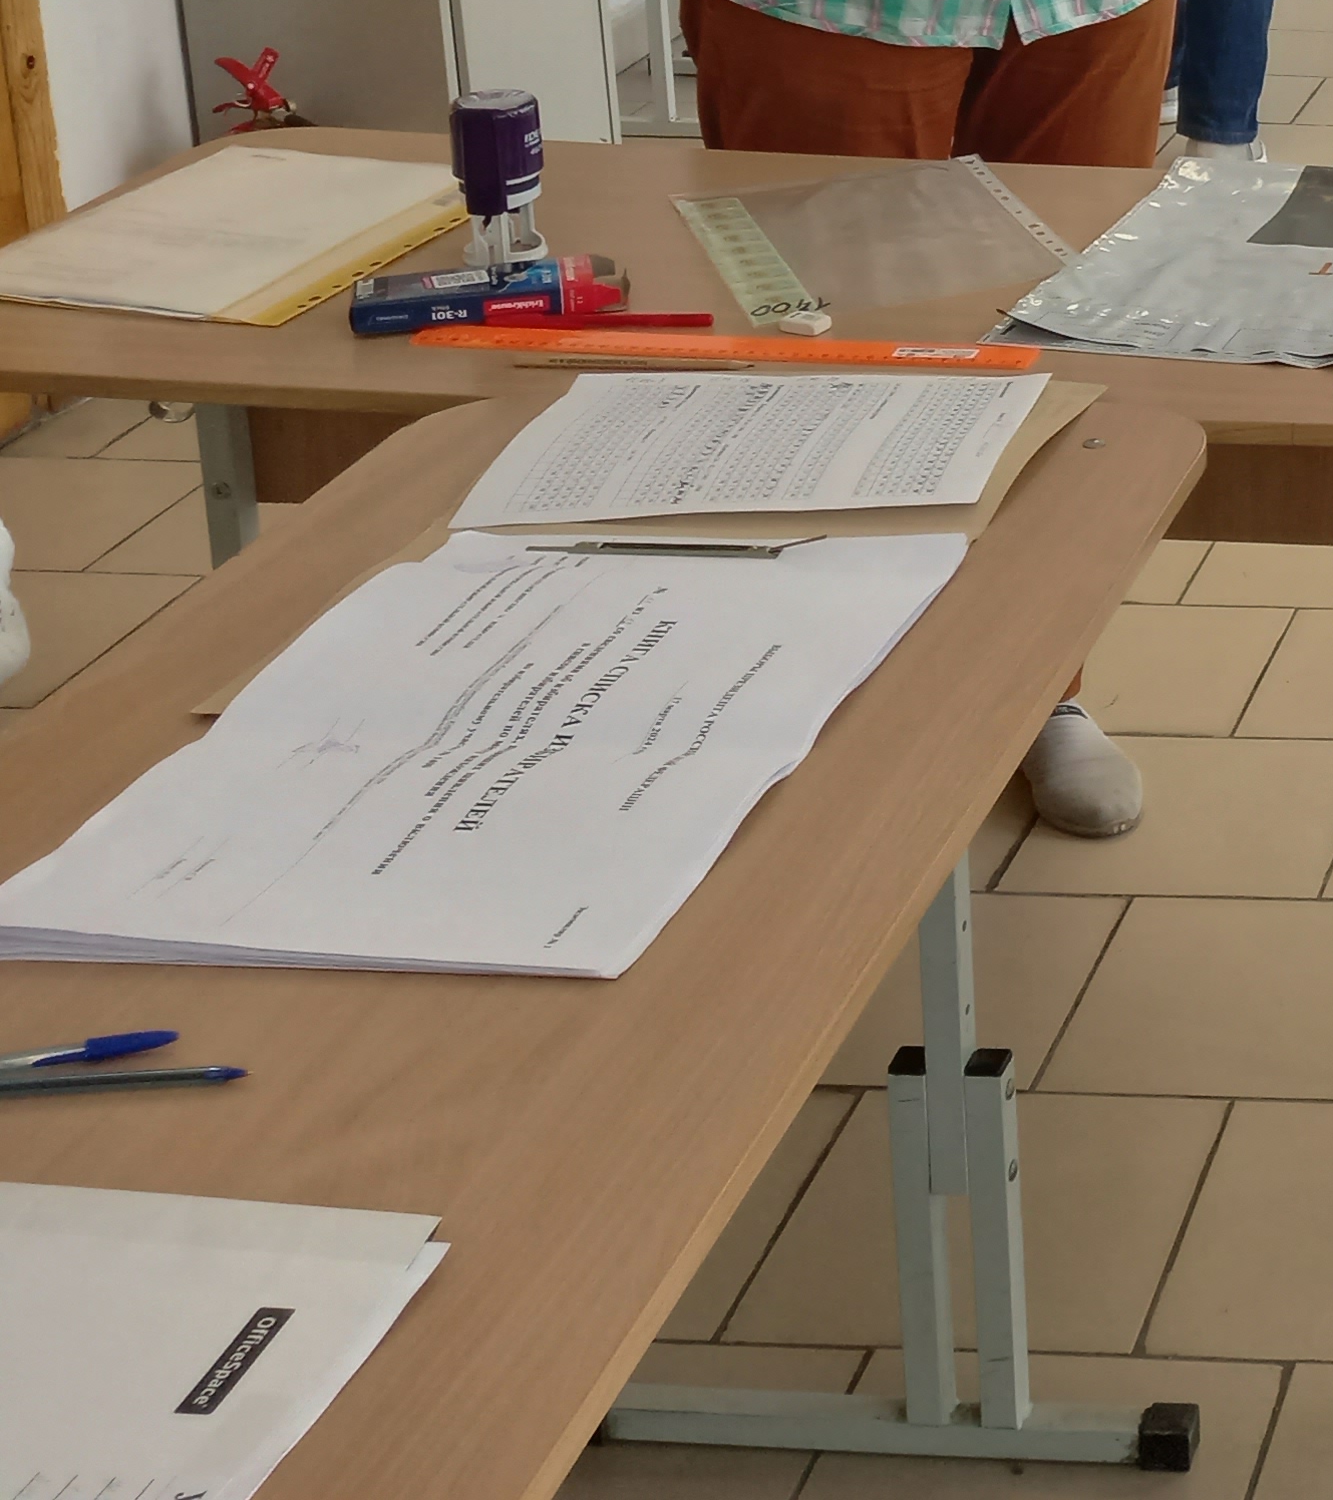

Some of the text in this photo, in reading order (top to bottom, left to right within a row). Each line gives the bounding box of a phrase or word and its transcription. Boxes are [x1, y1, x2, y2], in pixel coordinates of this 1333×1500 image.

[431, 309, 468, 322] R-301
[490, 298, 544, 313] ErichKrause
[621, 620, 678, 662] КНИГА
[561, 665, 629, 726] СПИСКА
[499, 724, 513, 739] по
[371, 823, 426, 877] включении
[190, 1315, 278, 1409] OfficeSpace
